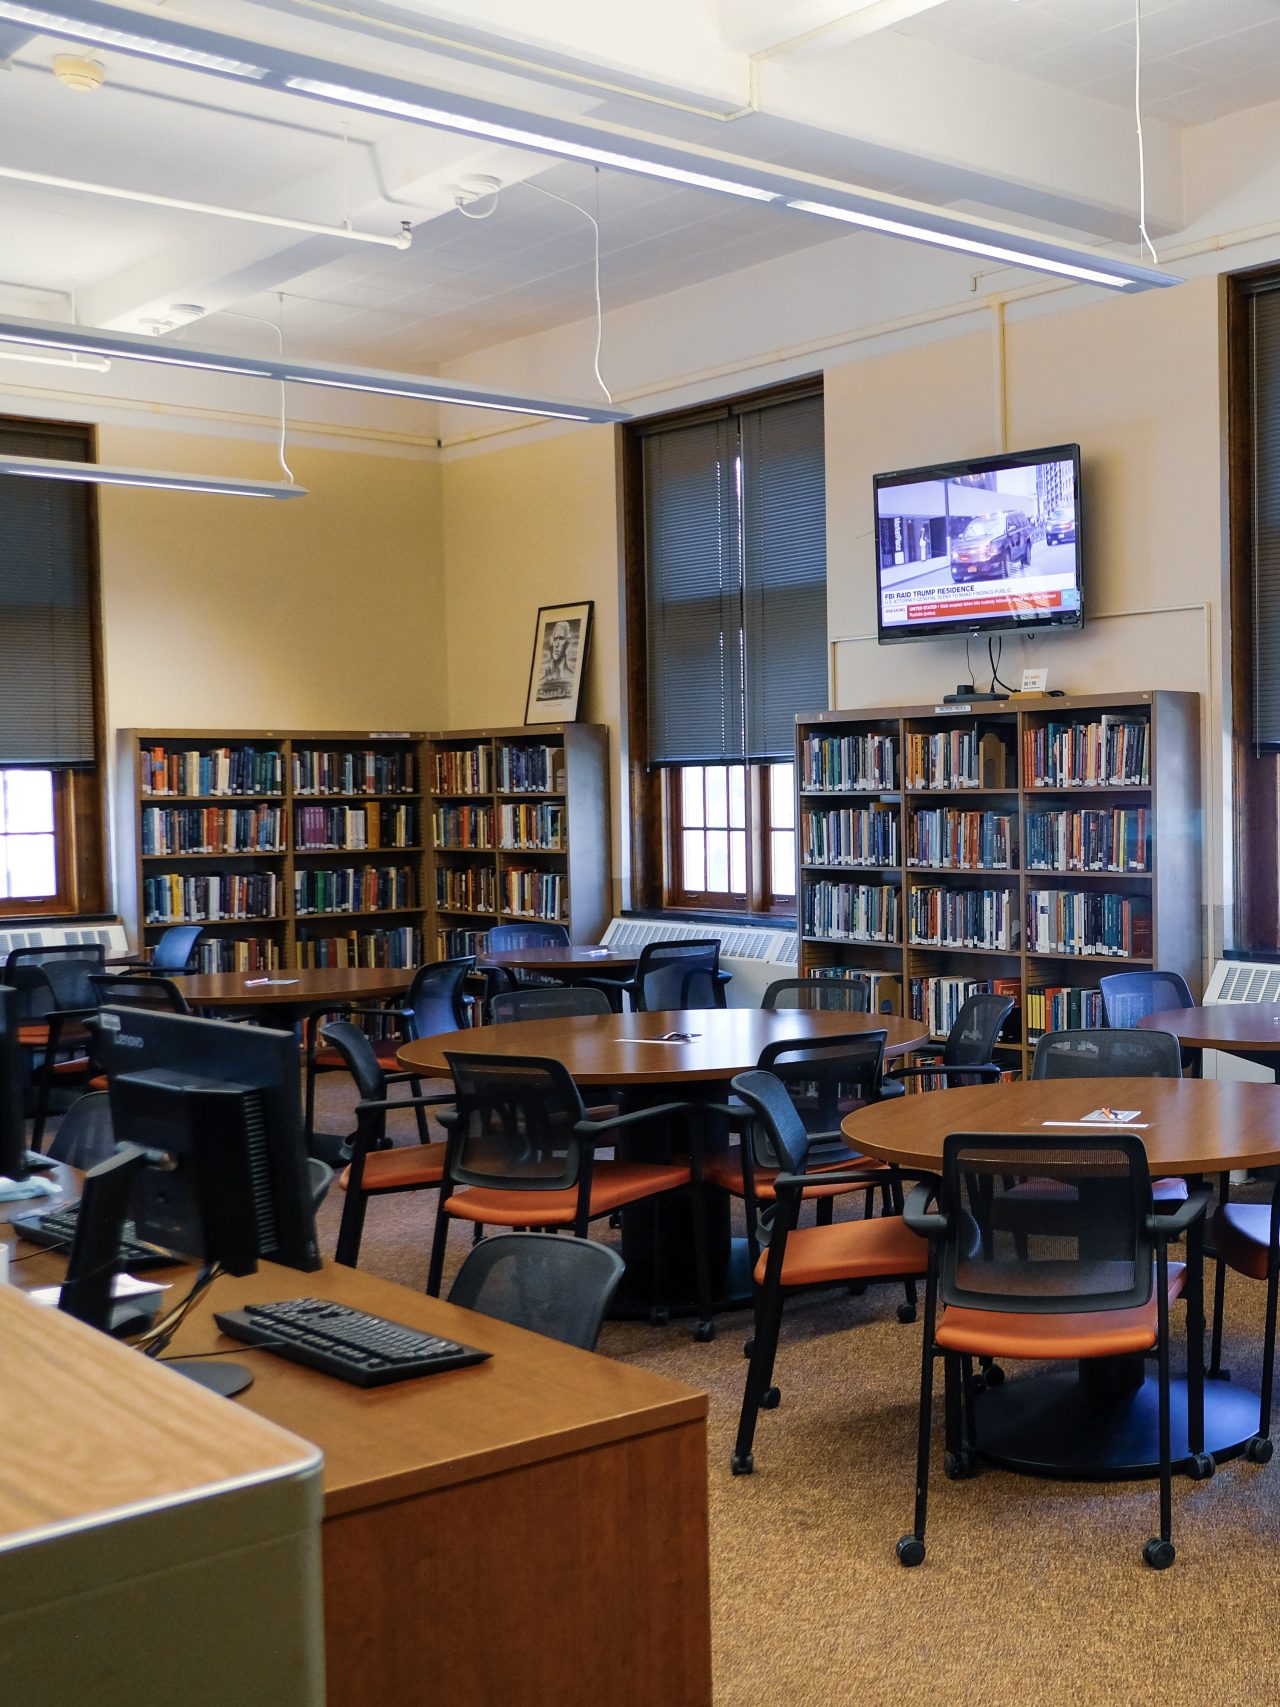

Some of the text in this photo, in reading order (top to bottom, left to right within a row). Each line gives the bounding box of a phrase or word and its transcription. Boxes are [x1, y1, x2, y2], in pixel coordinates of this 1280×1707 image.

[913, 589, 936, 597] TRUMP
[937, 585, 975, 594] RESIDENCE
[114, 1031, 144, 1048] Lenovo
